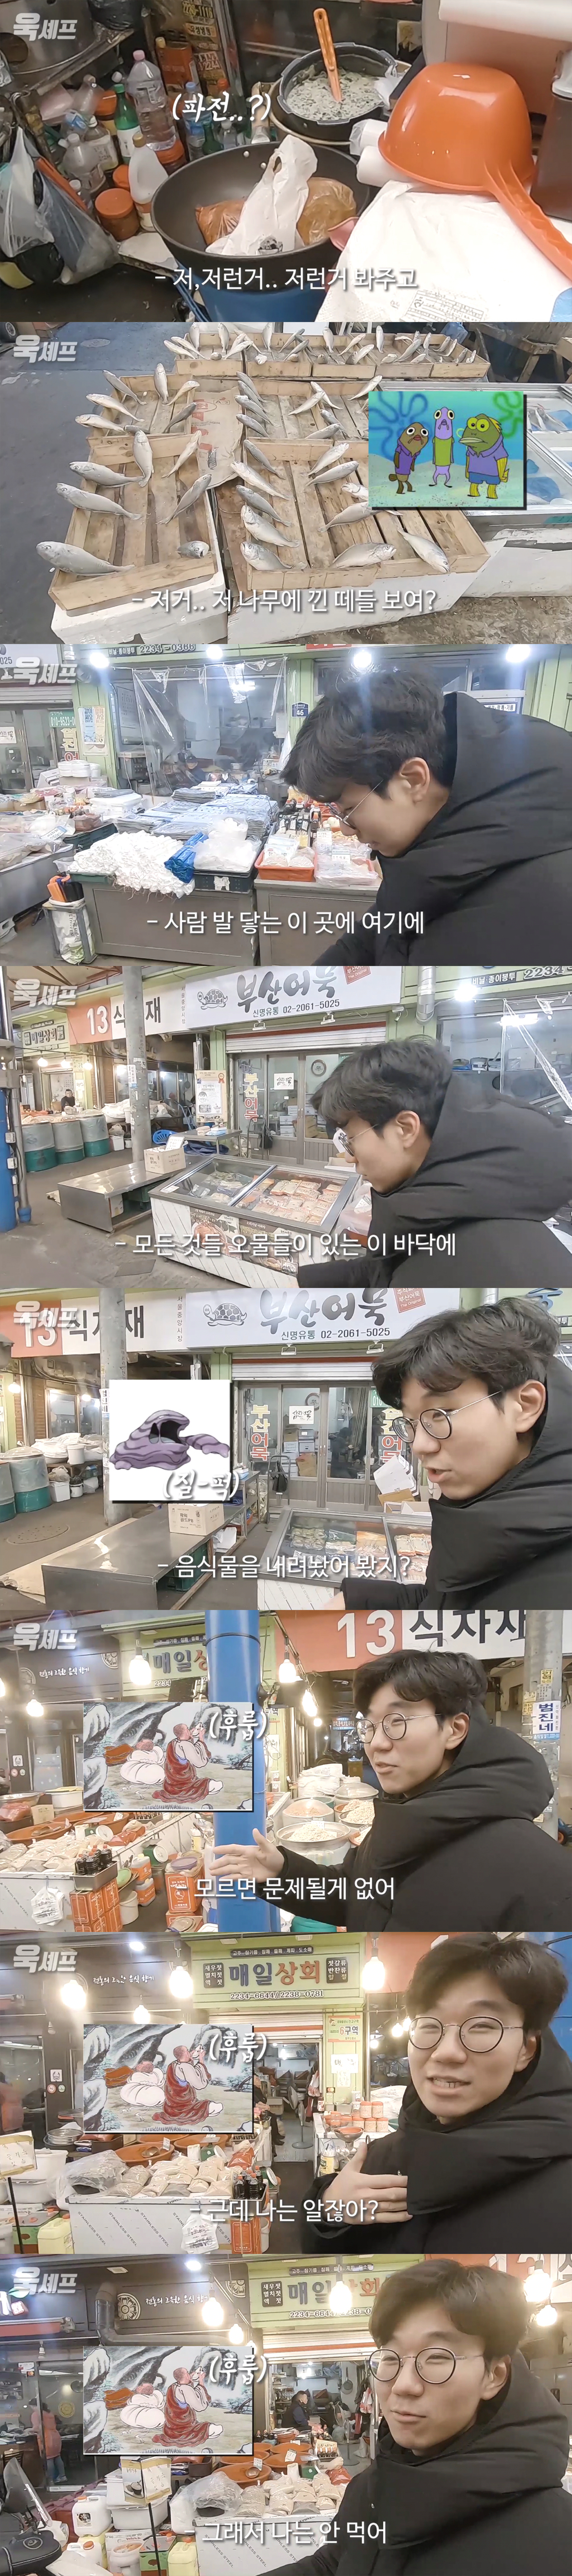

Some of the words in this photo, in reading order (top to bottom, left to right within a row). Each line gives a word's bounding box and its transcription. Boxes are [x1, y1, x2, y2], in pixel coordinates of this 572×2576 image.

[87, 1005, 109, 1035] 13
[252, 1007, 279, 1017] 신명유통
[283, 999, 340, 1014] 02-2061-5025
[244, 1073, 259, 1122] 부산어묵
[399, 1291, 420, 1303] 부산어묵
[260, 1288, 388, 1335] 부산어묵
[281, 1330, 316, 1341] 신명유통
[321, 1328, 390, 1339] 02-2061-5025
[250, 1404, 270, 1461] 부산어묵
[337, 1610, 395, 1659] 13
[538, 1703, 554, 1732] 범진네
[141, 1974, 155, 1983] 향기
[228, 1960, 320, 1987] 매일상회
[280, 1990, 324, 1999] 2238-0781
[340, 2026, 359, 2035] 6구역
[78, 2211, 96, 2234] STAINLESS
[96, 2234, 106, 2246] STEEL
[108, 2212, 127, 2234] STAINLESS
[127, 2234, 137, 2247] STEEL
[140, 2212, 159, 2235] STAINLESS
[158, 2234, 169, 2247] STEEL
[145, 2296, 163, 2307] 전통의
[183, 2294, 195, 2305] 음식
[223, 2556, 234, 2568] STEEL
[256, 2556, 267, 2568] STEEL
